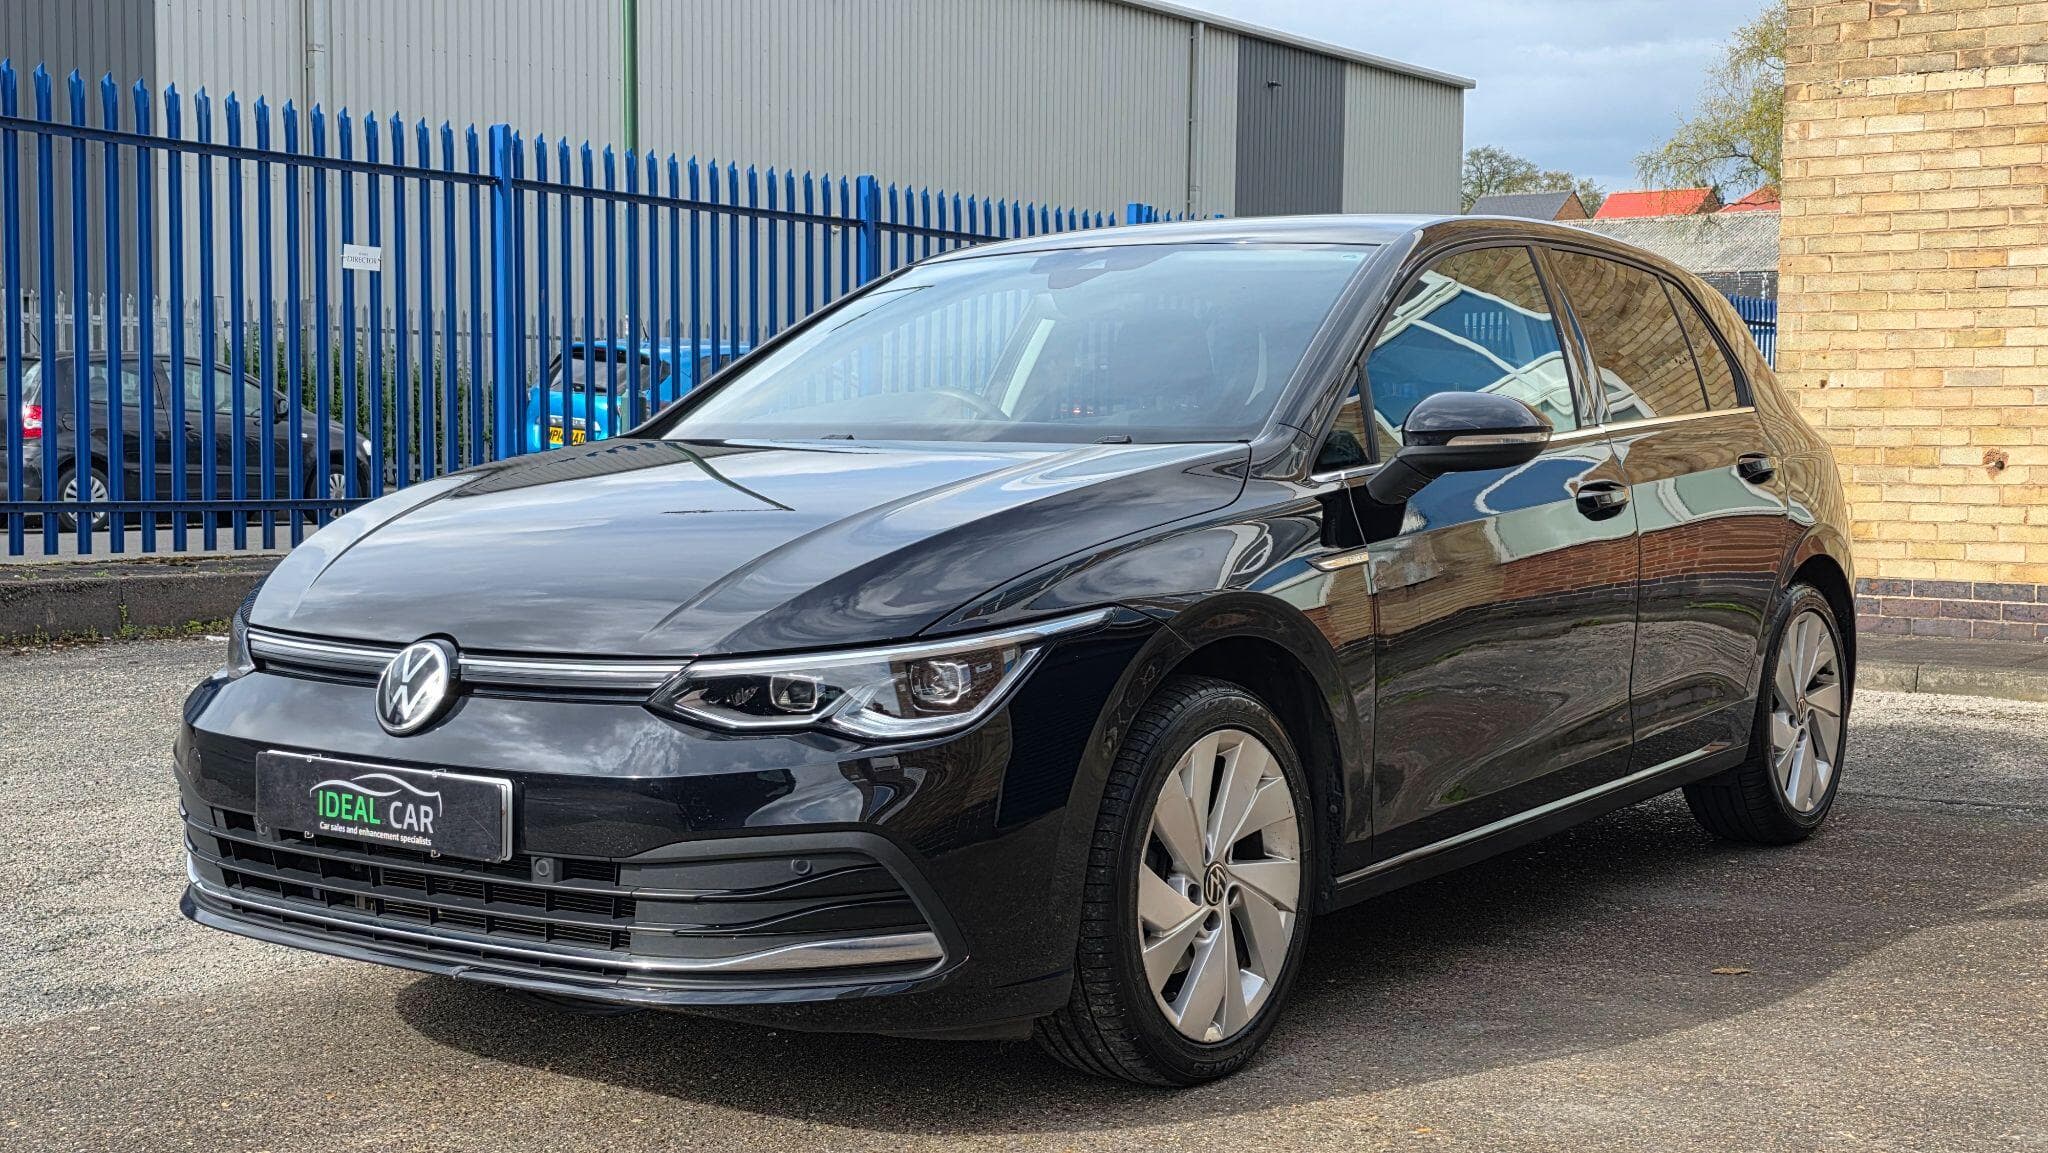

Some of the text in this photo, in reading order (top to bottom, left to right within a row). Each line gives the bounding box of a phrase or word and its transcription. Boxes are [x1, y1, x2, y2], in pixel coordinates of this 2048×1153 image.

[319, 789, 434, 834] IDEAL CAR
[319, 821, 432, 846] Car sales and enhancement specialists
